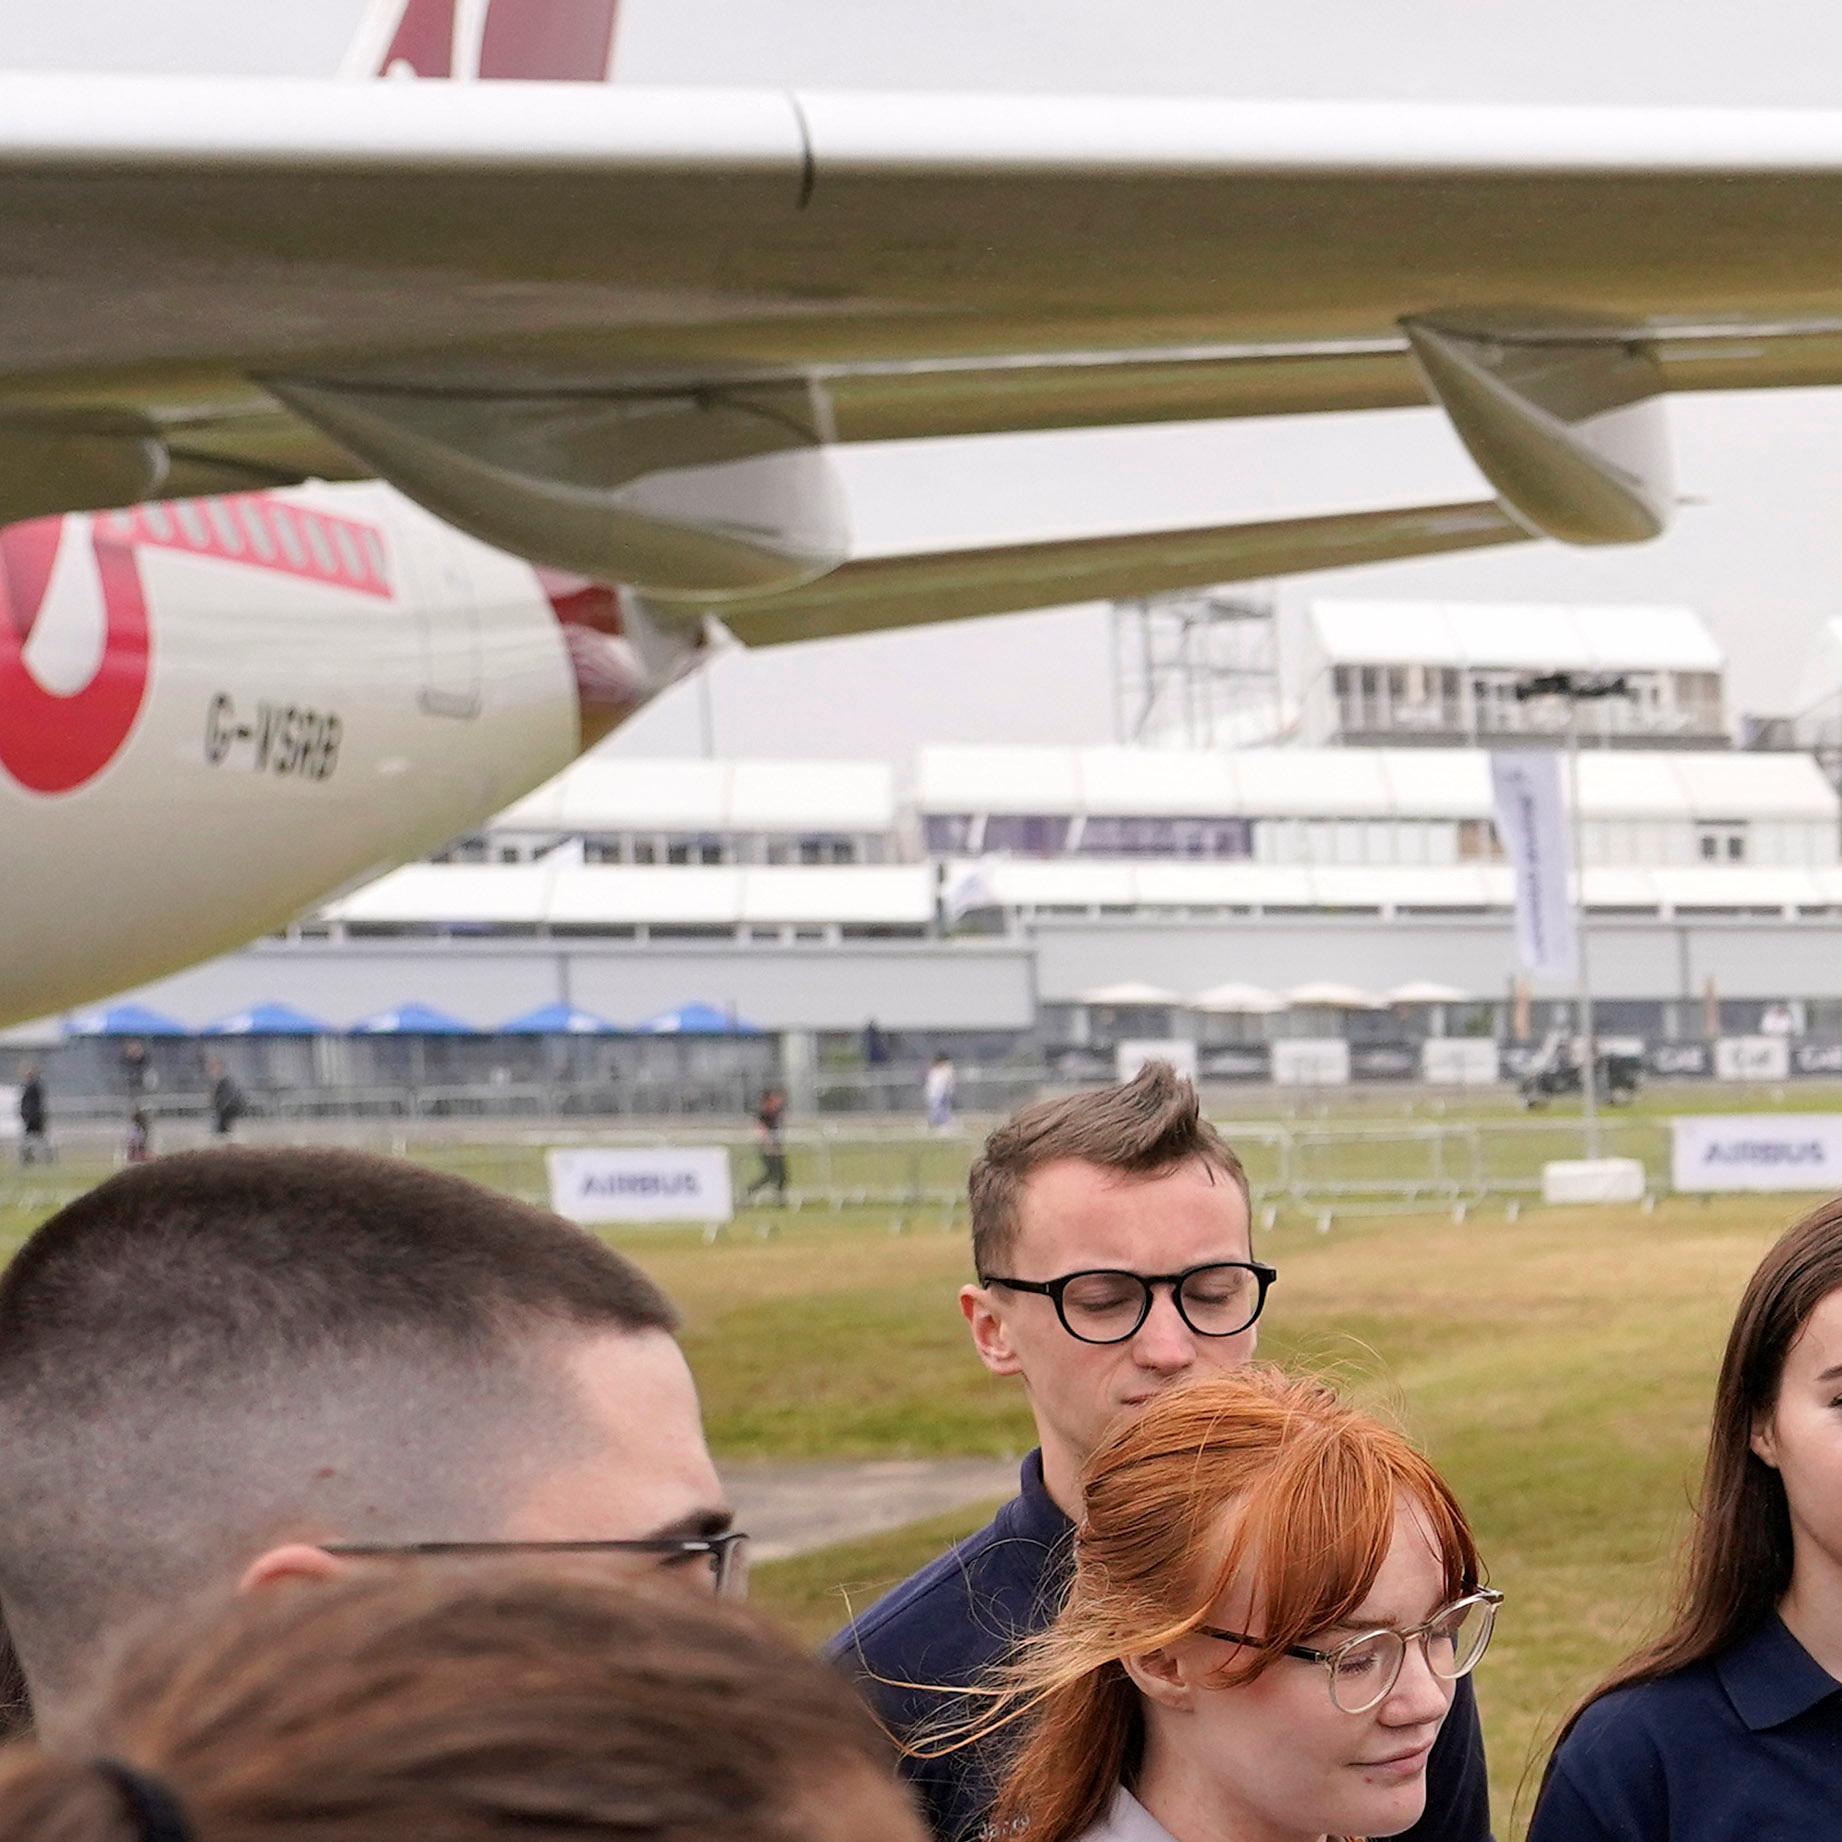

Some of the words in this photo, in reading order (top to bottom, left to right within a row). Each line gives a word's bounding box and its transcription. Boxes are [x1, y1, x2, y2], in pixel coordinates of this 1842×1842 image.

[204, 692, 343, 781] G-VSRB
[1702, 1141, 1826, 1165] AIRBUS
[579, 1170, 700, 1197] AIRBUS
